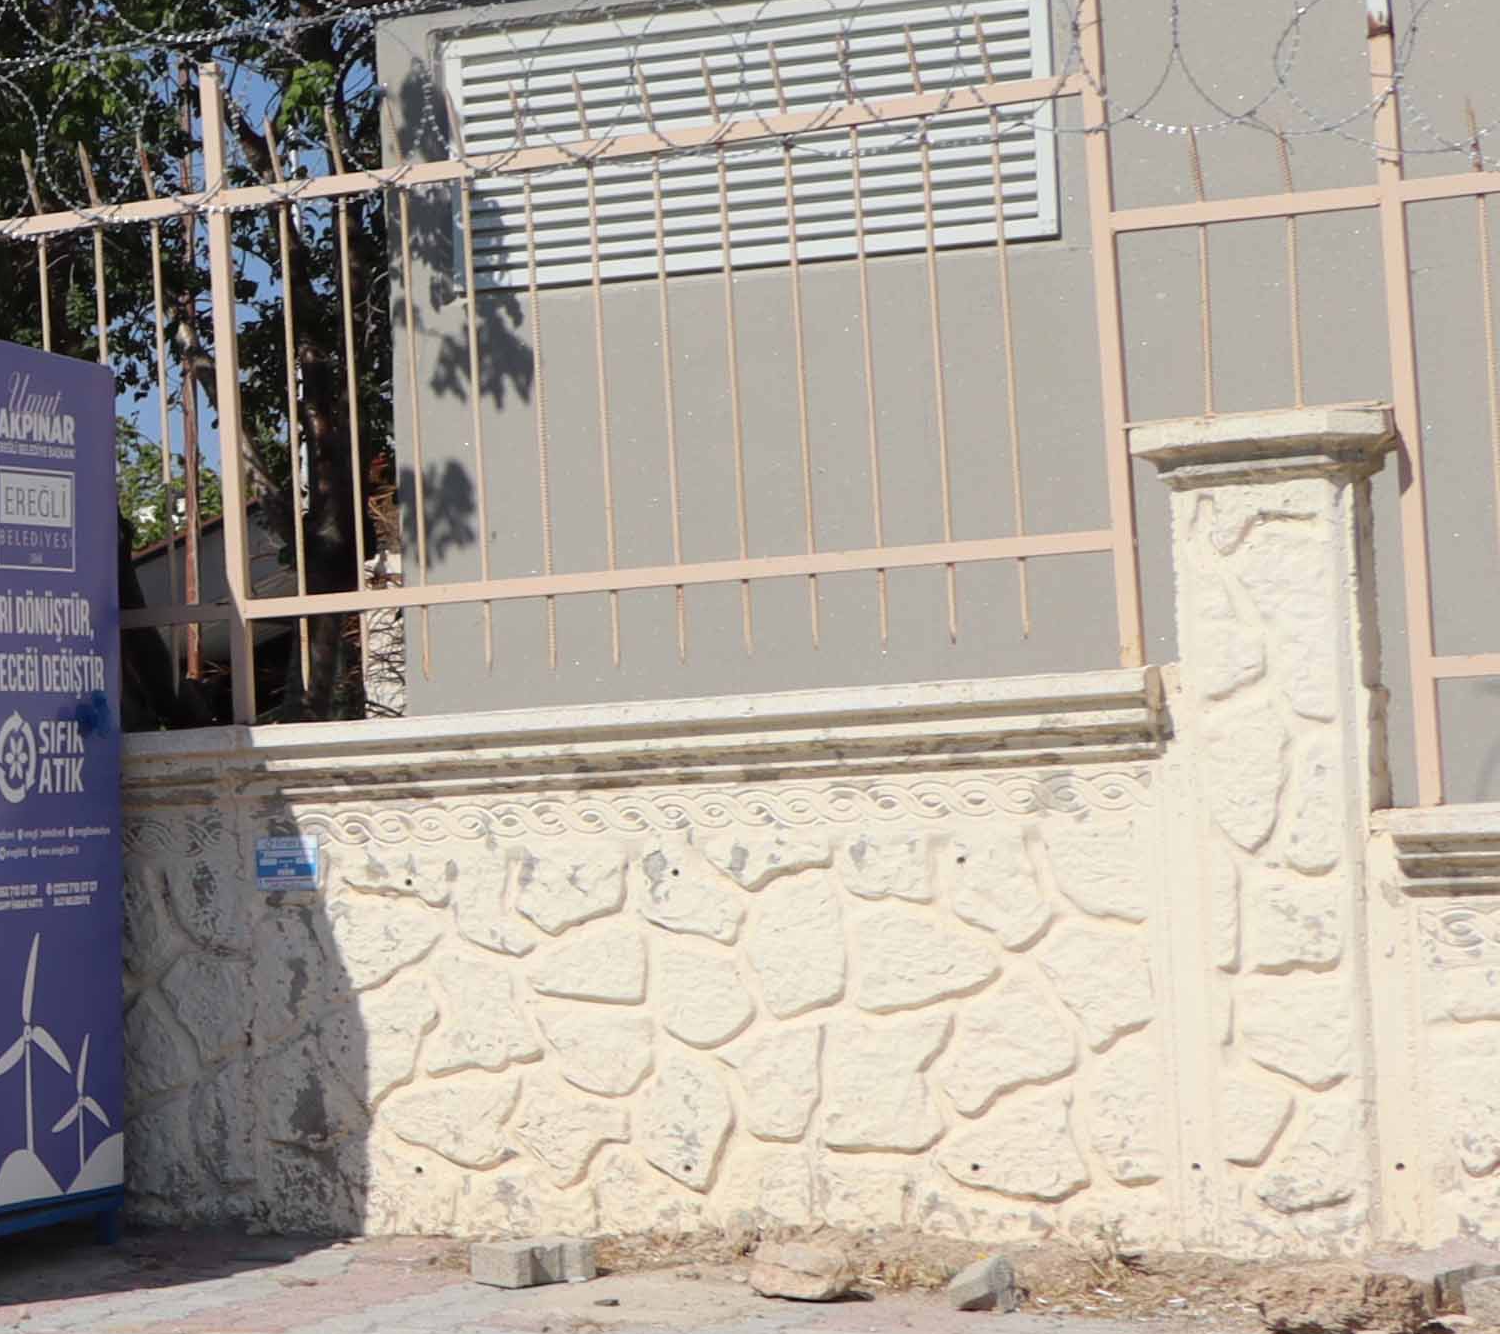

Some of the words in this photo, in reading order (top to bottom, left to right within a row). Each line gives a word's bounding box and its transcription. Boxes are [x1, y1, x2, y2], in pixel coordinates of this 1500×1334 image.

[7, 371, 62, 414] Umut
[4, 484, 67, 519] EREĞLİ
[42, 648, 105, 700] DEĞİŞTİR
[38, 757, 85, 794] ATIK
